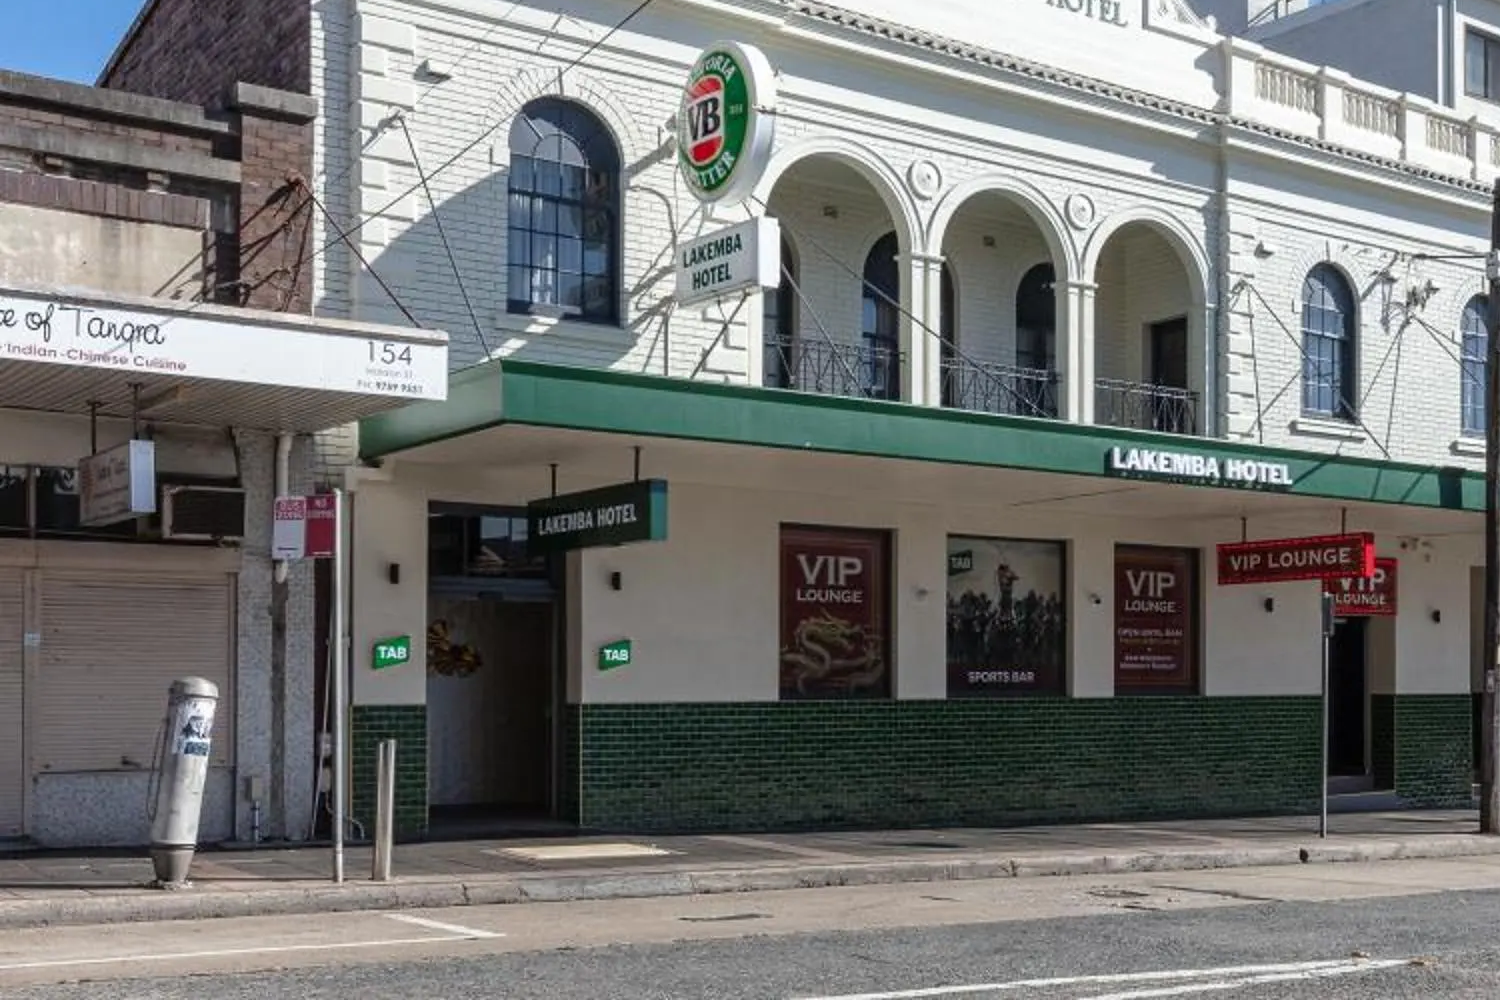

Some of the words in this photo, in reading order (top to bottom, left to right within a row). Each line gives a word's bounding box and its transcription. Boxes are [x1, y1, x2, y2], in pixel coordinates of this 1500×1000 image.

[687, 97, 721, 142] VB
[683, 233, 743, 268] LAKEMBA
[692, 262, 732, 290] HOTEL
[25, 303, 55, 342] of
[133, 355, 188, 371] Cuisine
[368, 340, 412, 366] 154
[1112, 446, 1220, 479] LAKEMBA
[1226, 459, 1294, 485] HOTEL
[538, 510, 593, 536] LAKEMBA
[597, 503, 638, 527] HOTEL
[796, 554, 863, 586] VIP
[1231, 553, 1261, 571] VIP
[1268, 547, 1351, 569] LOUNGE
[796, 588, 864, 604] LOUNGE
[1125, 569, 1176, 598] VIP
[1124, 599, 1177, 613] LOUNGE
[1335, 593, 1387, 606] LOUNGE
[377, 645, 408, 660] TAB
[603, 648, 629, 661] TAB
[967, 671, 1010, 683] SPORTS
[1011, 671, 1035, 683] BAR
